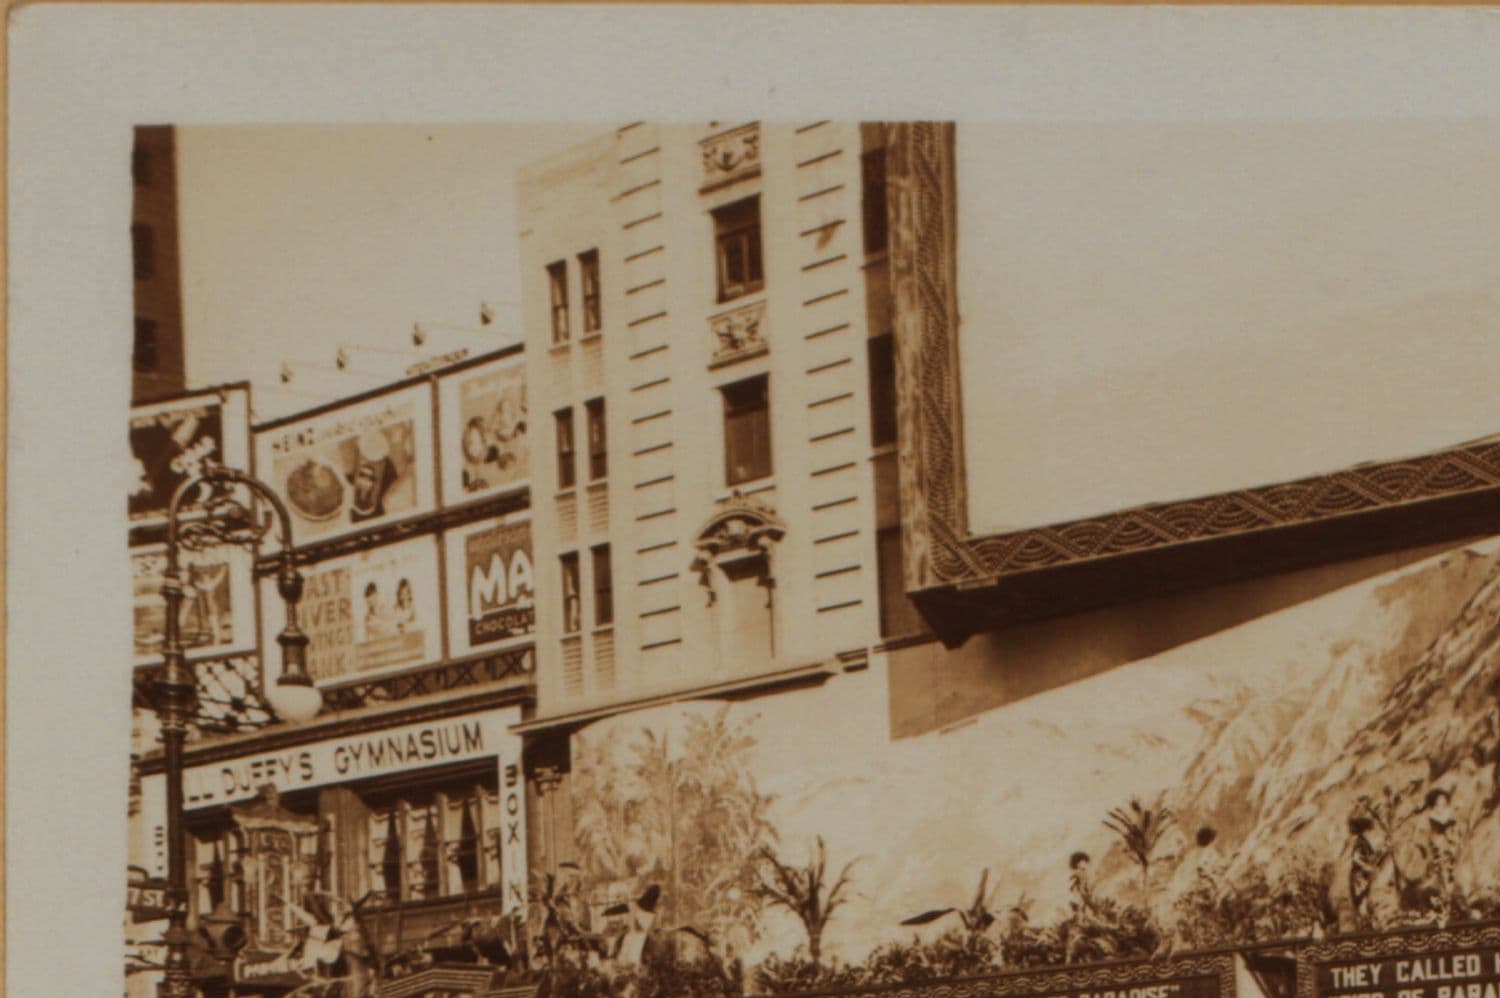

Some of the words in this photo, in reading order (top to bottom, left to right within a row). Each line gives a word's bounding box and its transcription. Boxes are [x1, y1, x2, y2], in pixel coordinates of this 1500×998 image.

[333, 721, 485, 776] GYMNASIUM
[1329, 962, 1383, 989] THEY
[1395, 954, 1481, 983] CALLED
